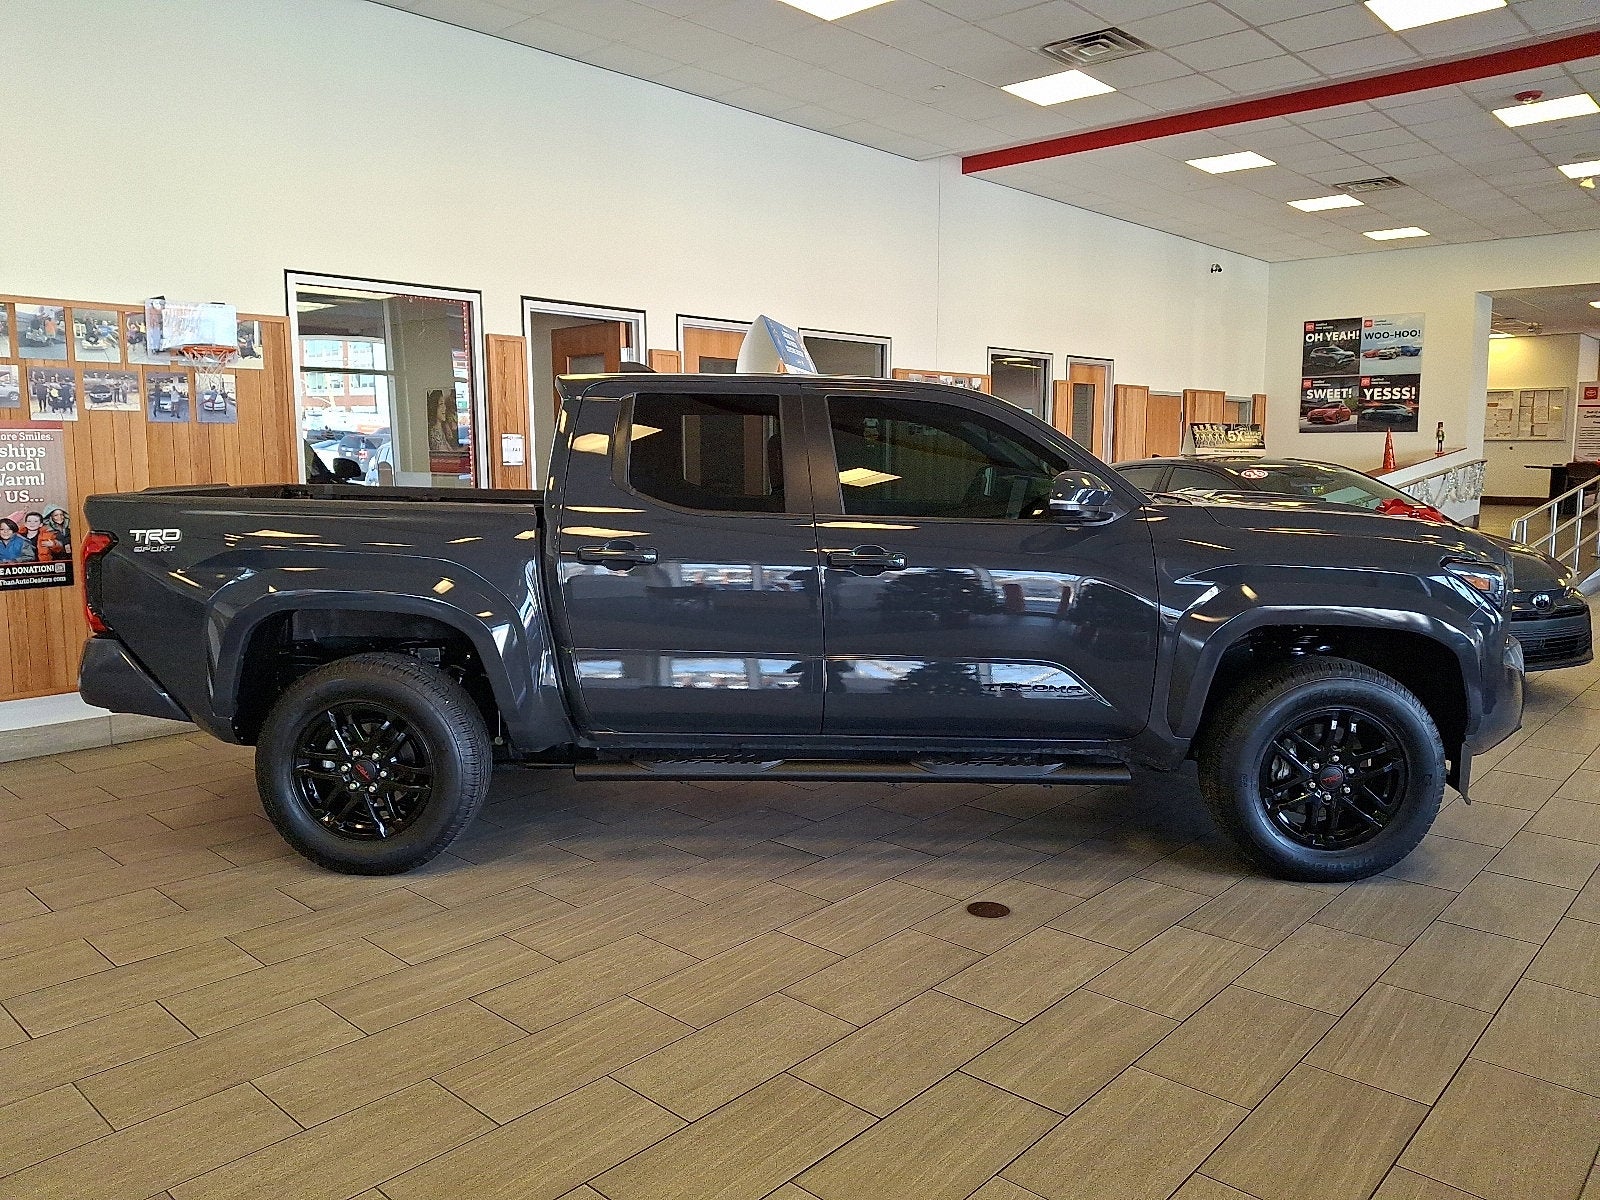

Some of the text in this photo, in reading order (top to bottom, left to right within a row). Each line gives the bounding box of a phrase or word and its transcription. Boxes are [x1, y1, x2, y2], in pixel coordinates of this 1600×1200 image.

[1305, 330, 1360, 342] OH YEAH!
[1364, 329, 1421, 340] WOO-HOO!
[1306, 388, 1352, 399] SWEET!
[1363, 387, 1416, 400] YESSS!
[0, 431, 54, 441] ore Smiles.
[5, 489, 44, 503] US...
[129, 529, 181, 544] TRD
[12, 565, 54, 575] DONATION!
[983, 683, 1082, 693] TACOMA
